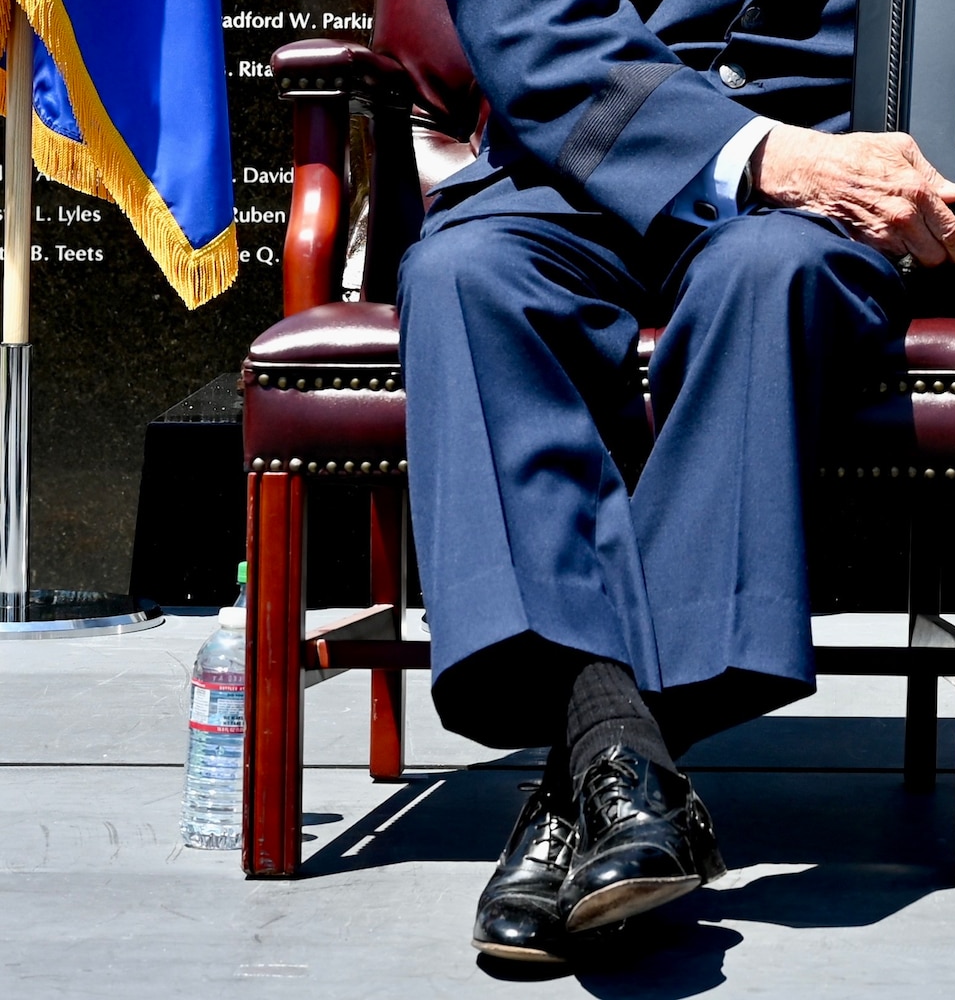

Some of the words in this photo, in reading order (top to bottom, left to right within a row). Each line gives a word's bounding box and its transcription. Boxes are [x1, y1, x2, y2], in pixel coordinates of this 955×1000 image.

[221, 11, 284, 29] adford
[288, 12, 316, 30] W.
[238, 60, 274, 78] Rita
[243, 166, 294, 184] David
[36, 205, 52, 222] L.
[58, 204, 102, 226] Lyles
[30, 244, 49, 262] B.
[55, 244, 104, 262] Teets
[256, 246, 280, 266] Q.
